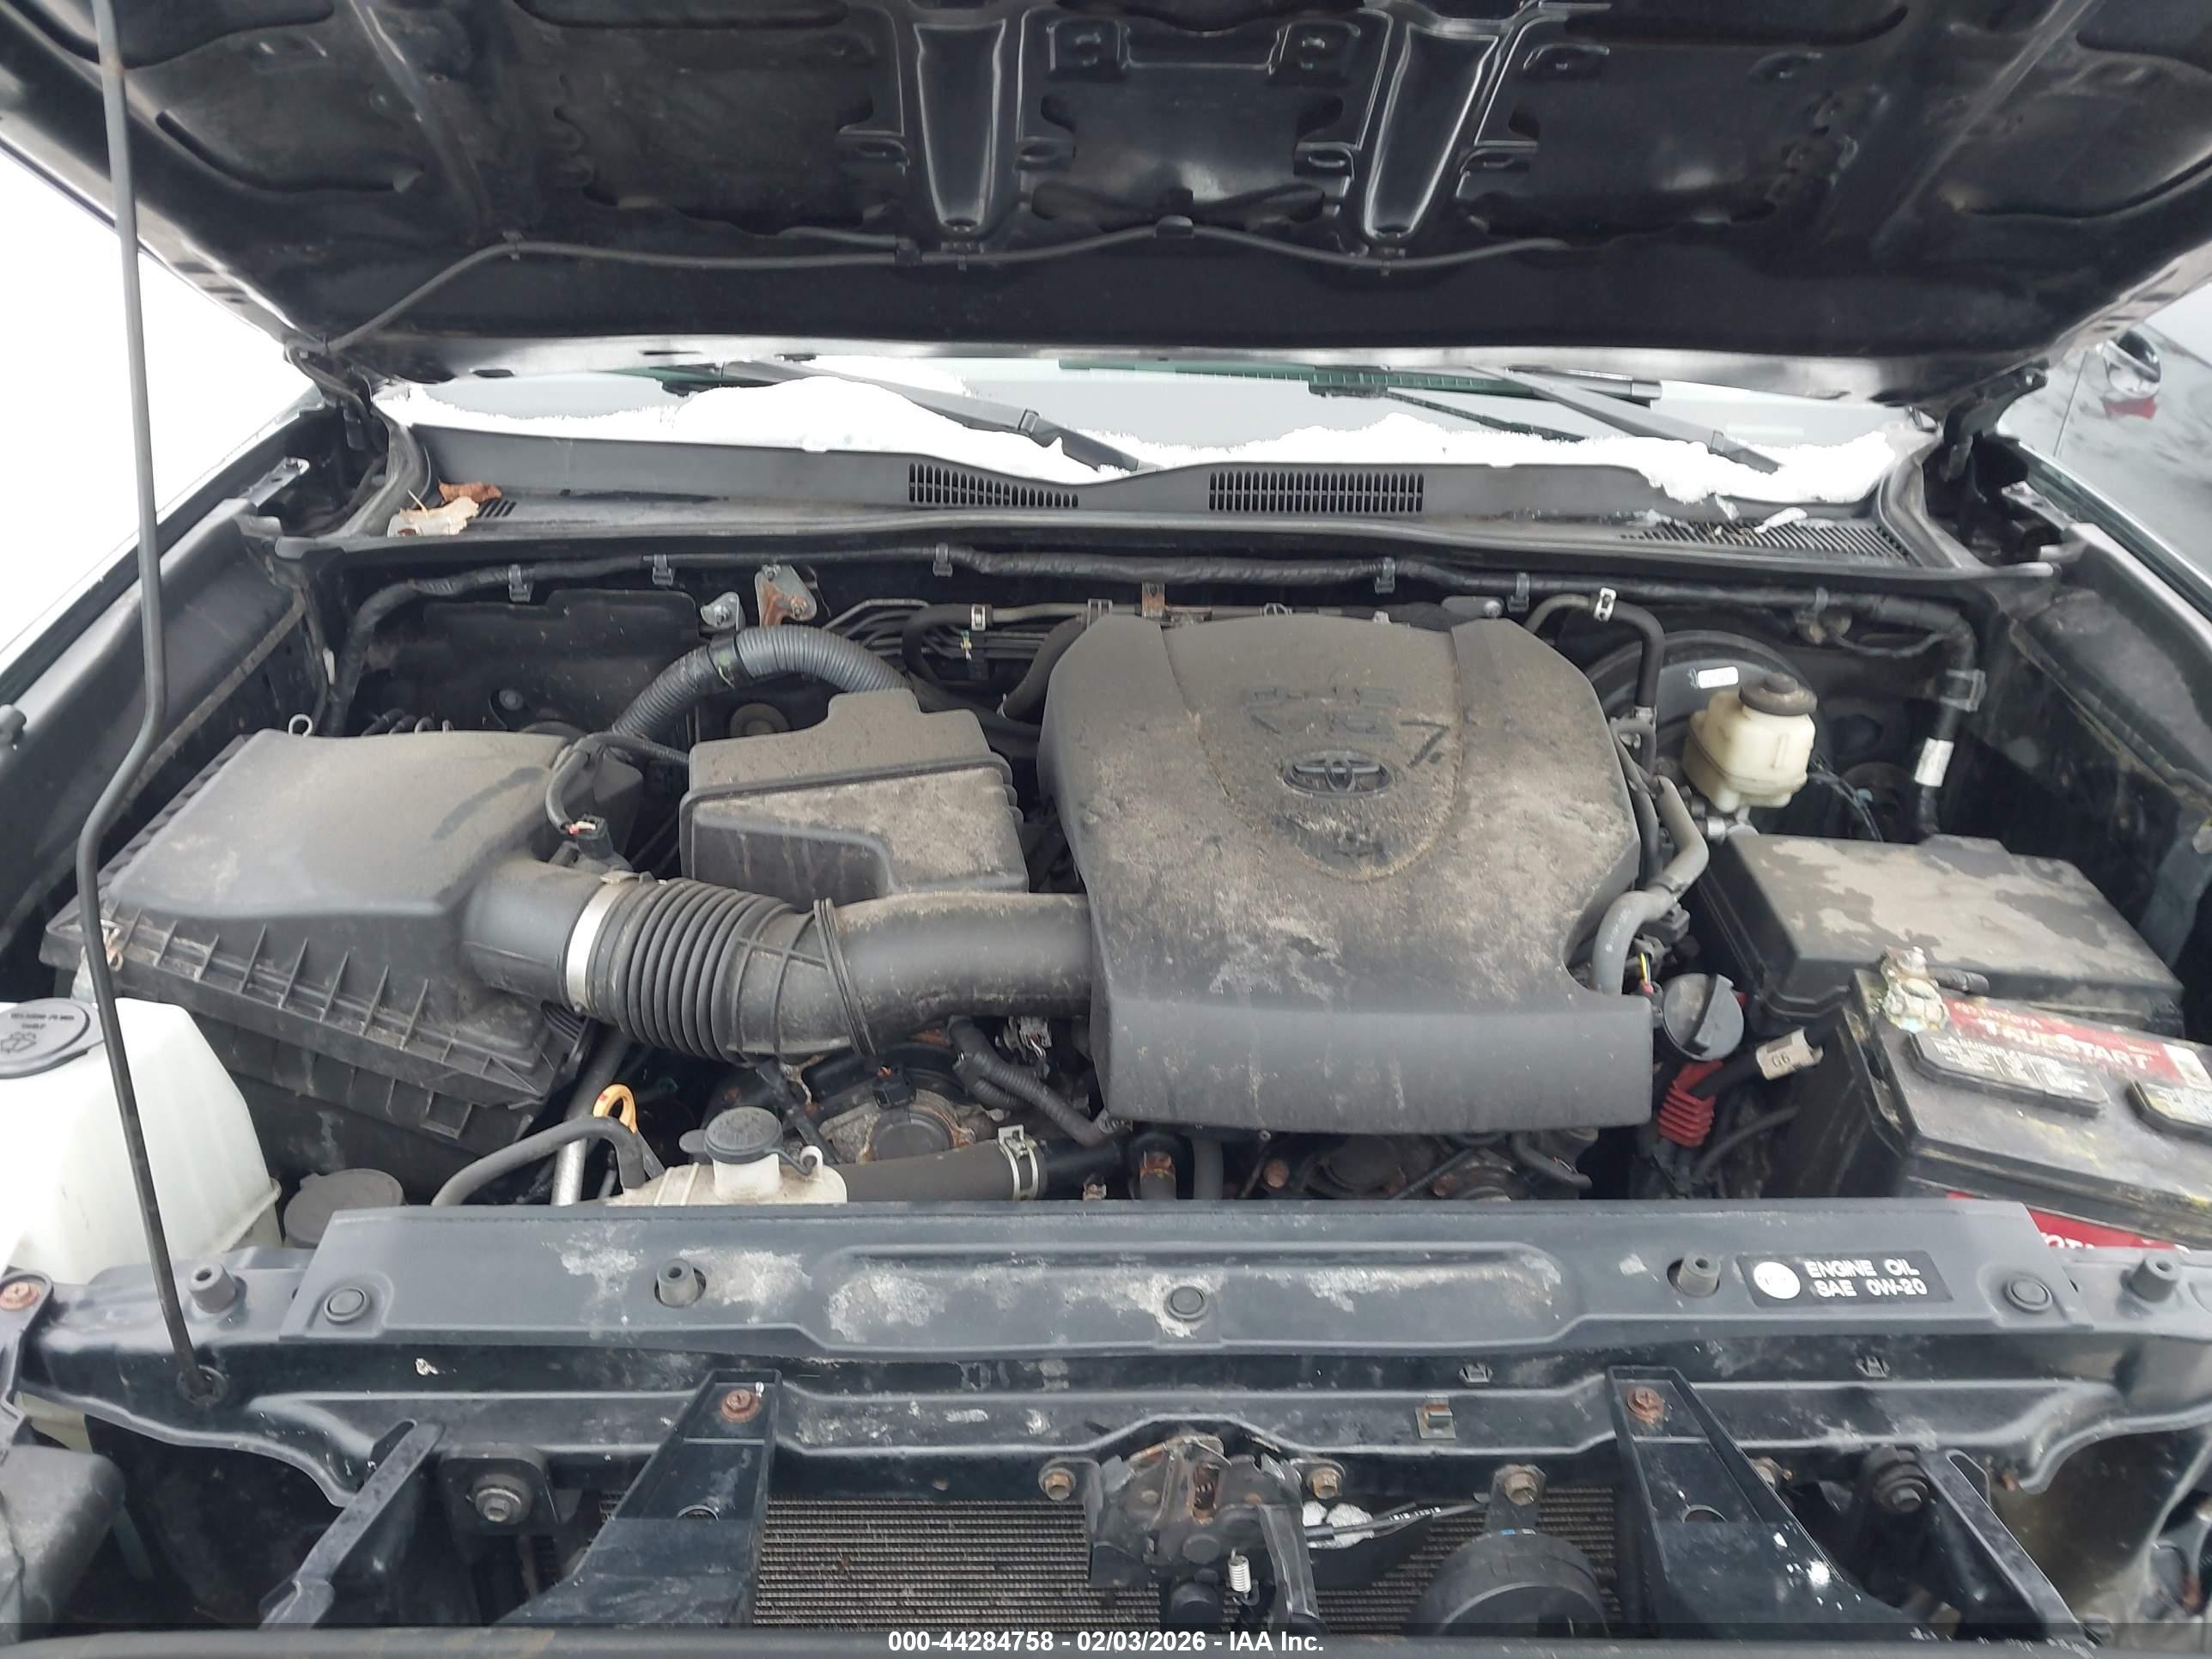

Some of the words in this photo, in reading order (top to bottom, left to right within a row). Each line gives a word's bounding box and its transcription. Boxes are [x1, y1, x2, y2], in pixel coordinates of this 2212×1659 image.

[1804, 1259, 1878, 1279] ENGINE
[1883, 1258, 1920, 1277] OIL
[1814, 1279, 1857, 1297] SAE
[1865, 1279, 1928, 1297] 0W-20
